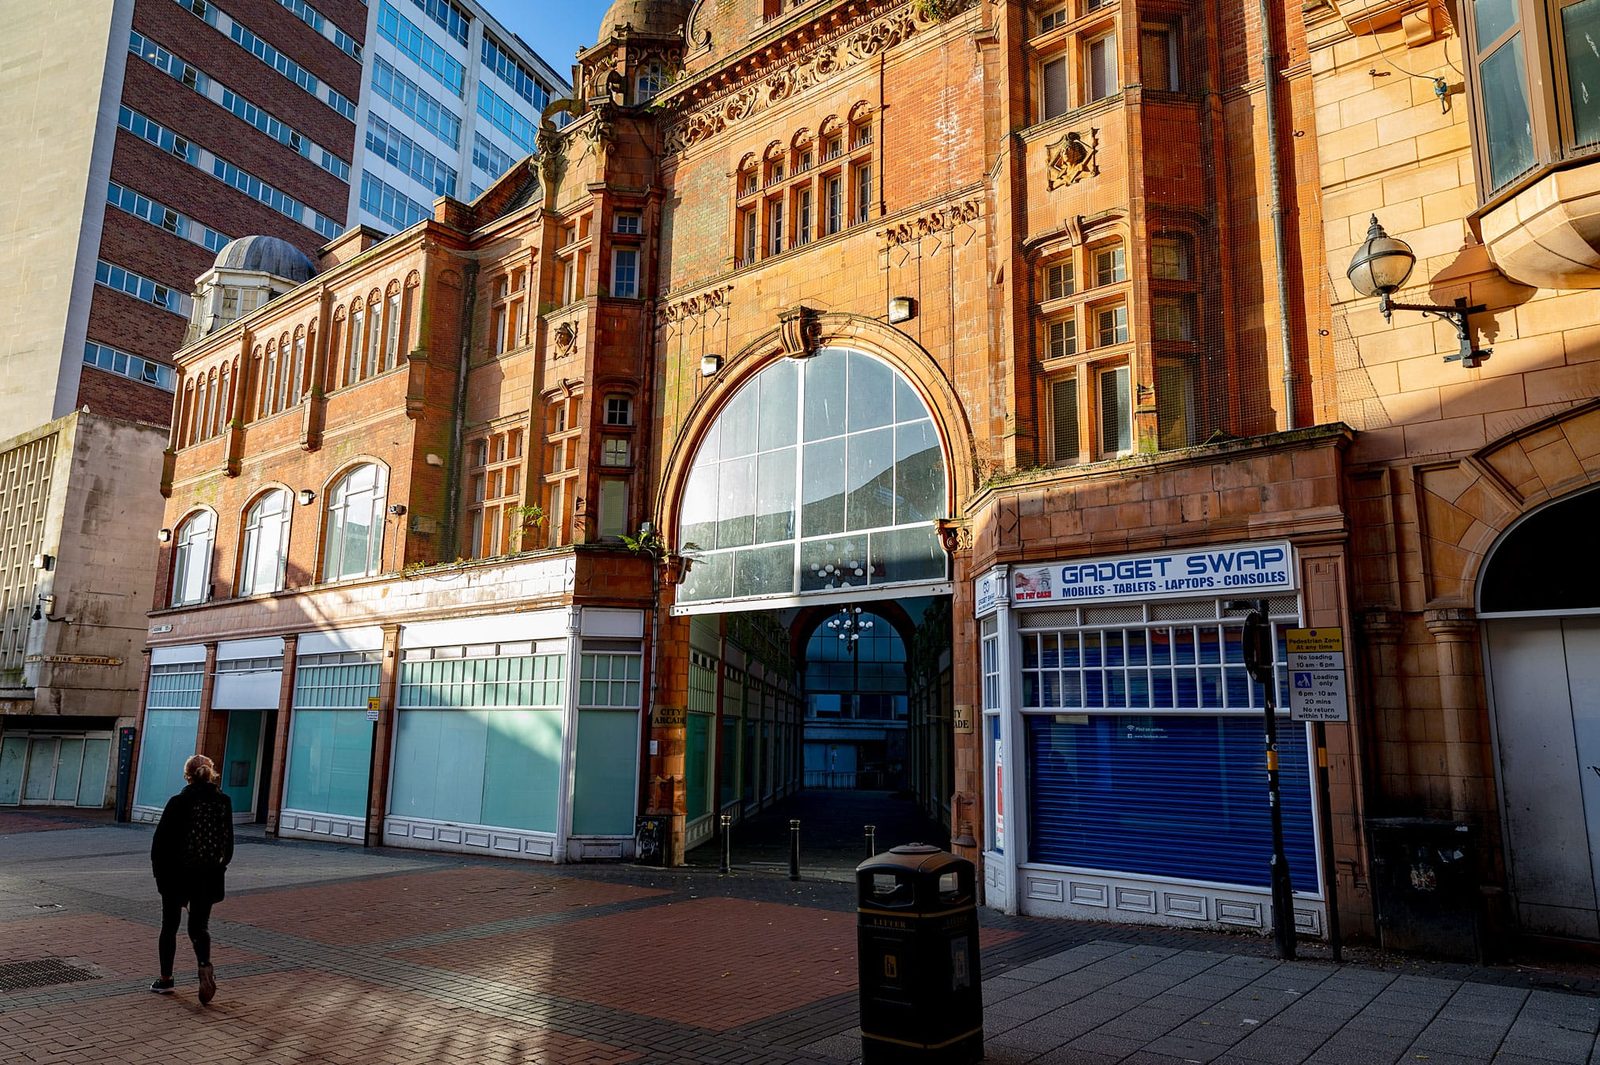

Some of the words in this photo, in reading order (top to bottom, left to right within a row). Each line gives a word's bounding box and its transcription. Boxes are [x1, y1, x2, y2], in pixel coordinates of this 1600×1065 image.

[1062, 557, 1172, 584] GADGET
[1186, 548, 1284, 575] SWAP
[1062, 585, 1105, 597] MOBILES
[1113, 581, 1156, 594] TABLETS
[1165, 576, 1214, 590] LAPTOPS
[1224, 571, 1286, 586] CONSOLES
[1026, 592, 1035, 600] PAY
[1036, 591, 1052, 599] CASH
[660, 708, 682, 716] CITY
